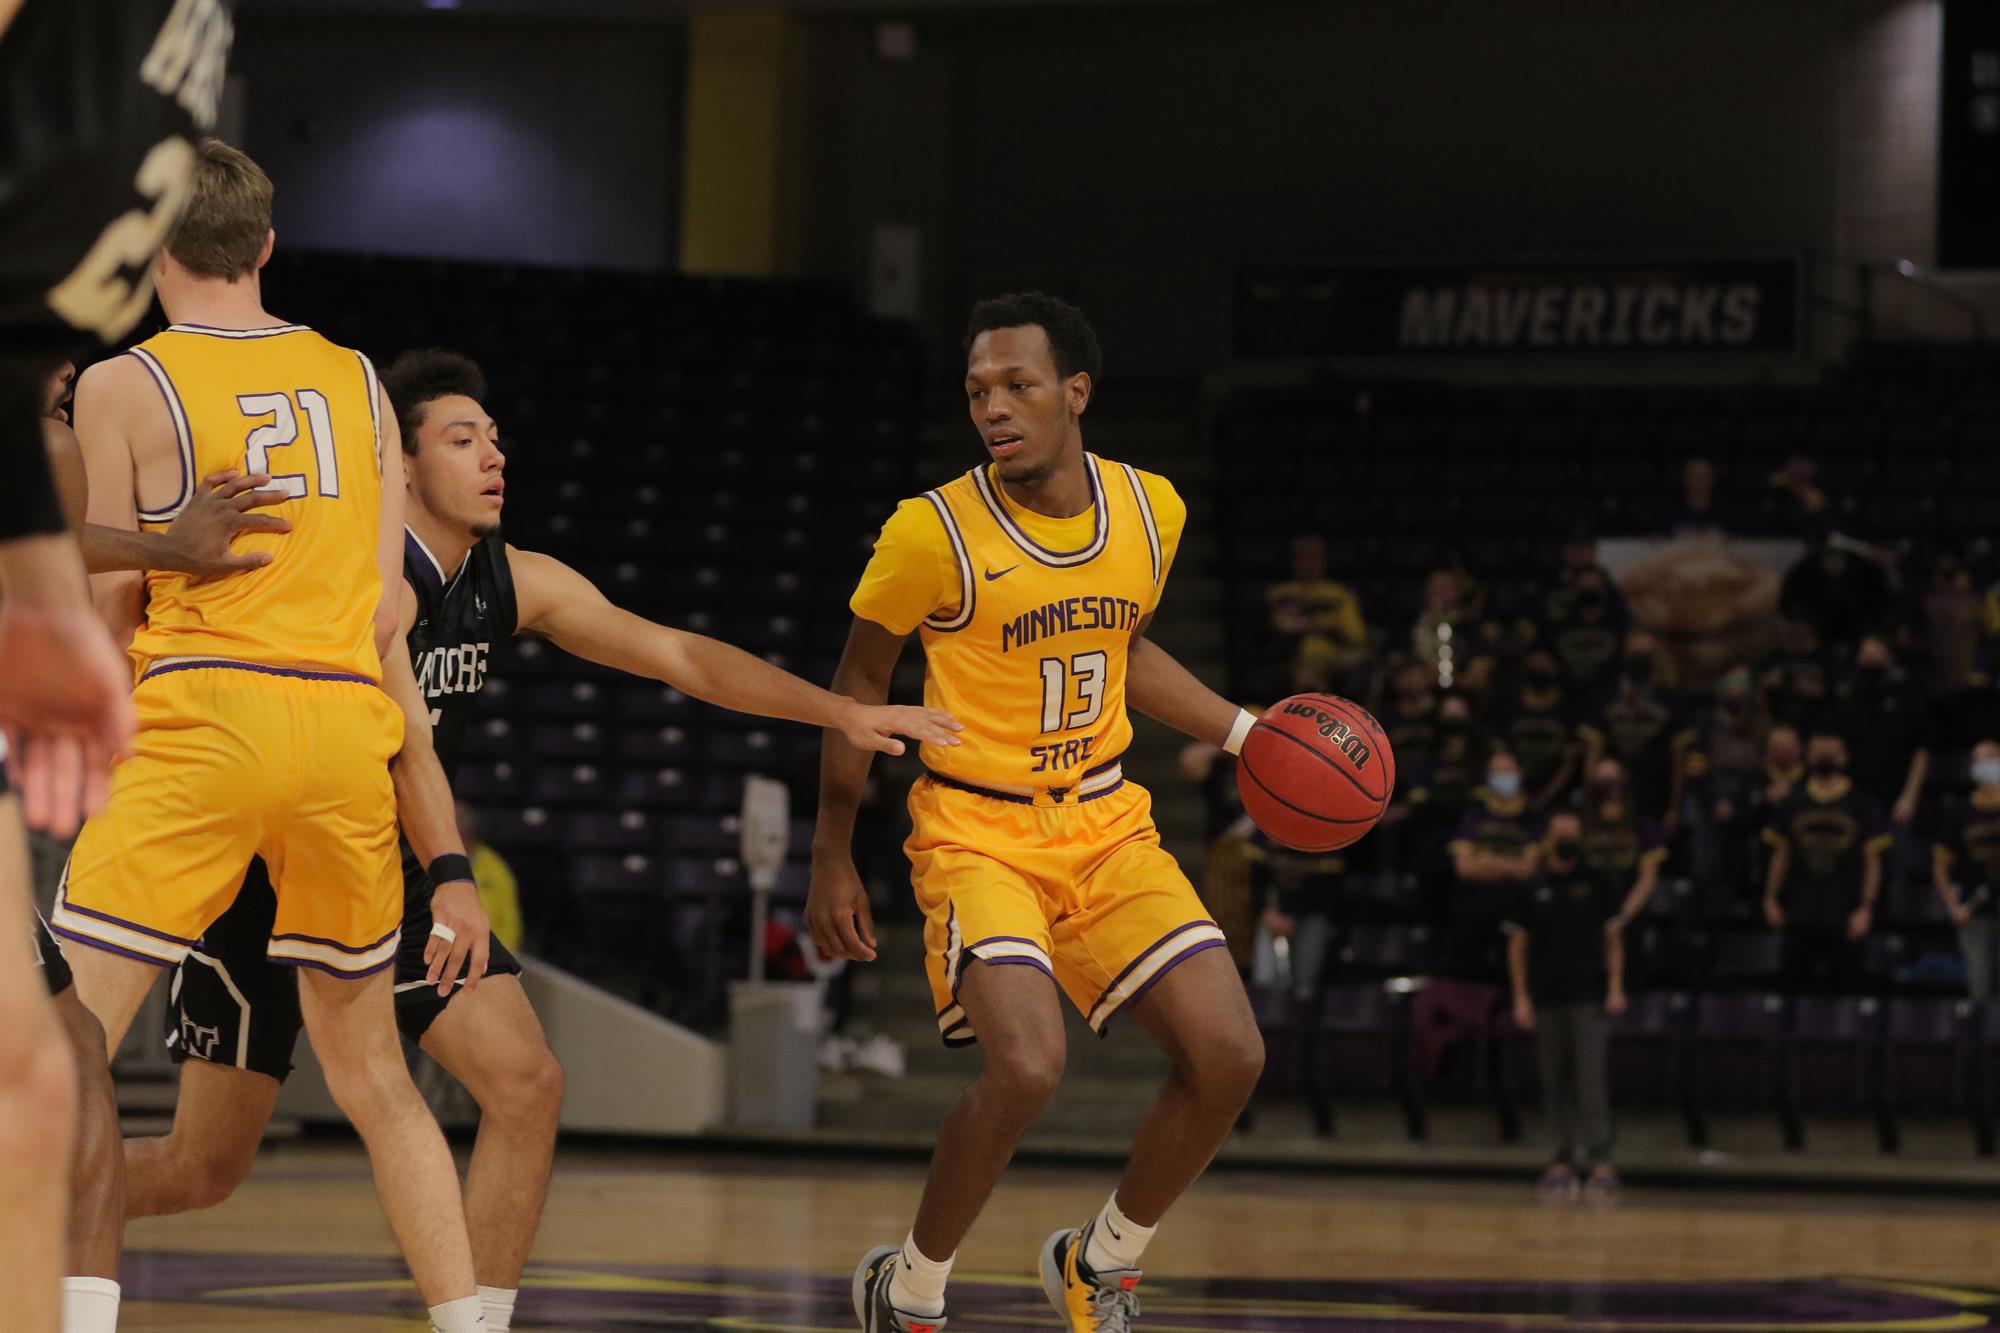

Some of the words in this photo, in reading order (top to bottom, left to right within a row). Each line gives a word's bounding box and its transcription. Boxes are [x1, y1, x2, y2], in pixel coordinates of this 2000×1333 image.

[1398, 283, 1763, 349] MAVERICKS
[236, 387, 340, 500] 21
[1002, 596, 1140, 653] MINNESOTA
[1039, 649, 1108, 735] 13
[1030, 735, 1098, 773] STAT
[1283, 702, 1371, 771] Wilson
